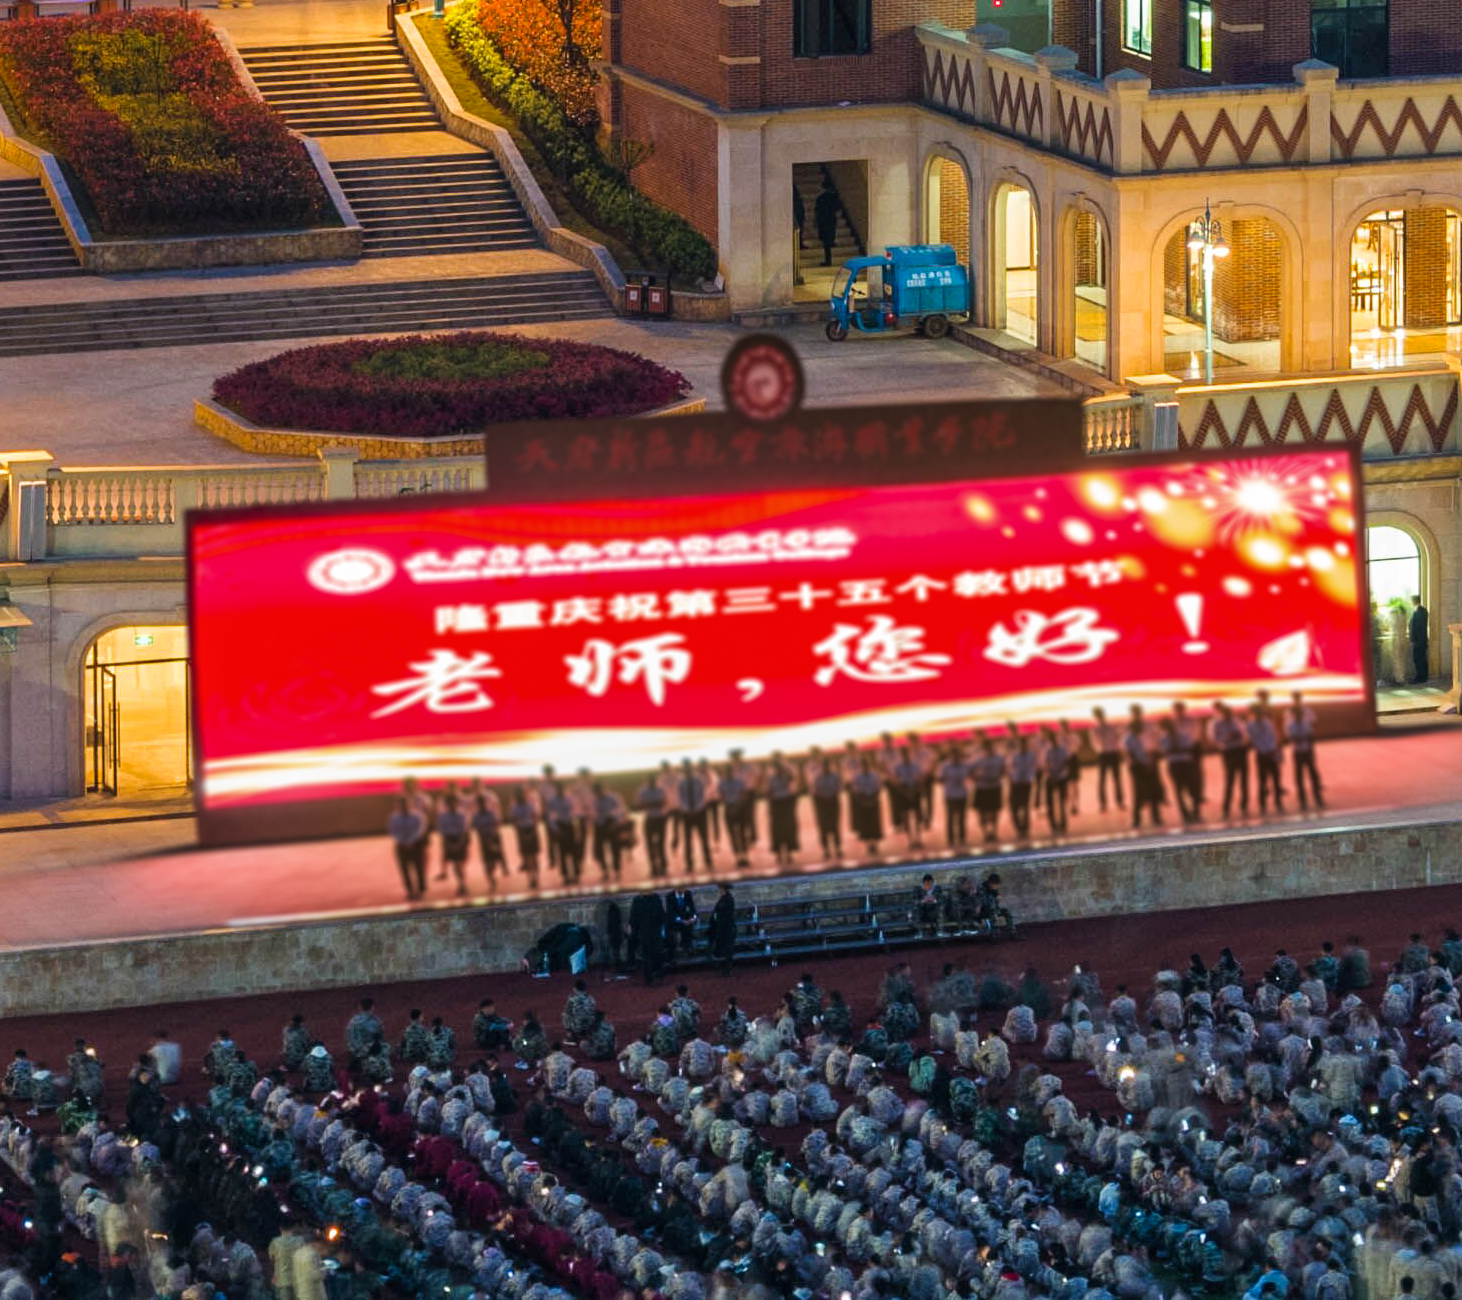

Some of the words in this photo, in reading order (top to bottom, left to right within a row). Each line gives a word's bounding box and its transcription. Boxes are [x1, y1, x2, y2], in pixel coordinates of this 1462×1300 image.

[435, 560, 1126, 633] 隆重庆祝第三十五个教师节
